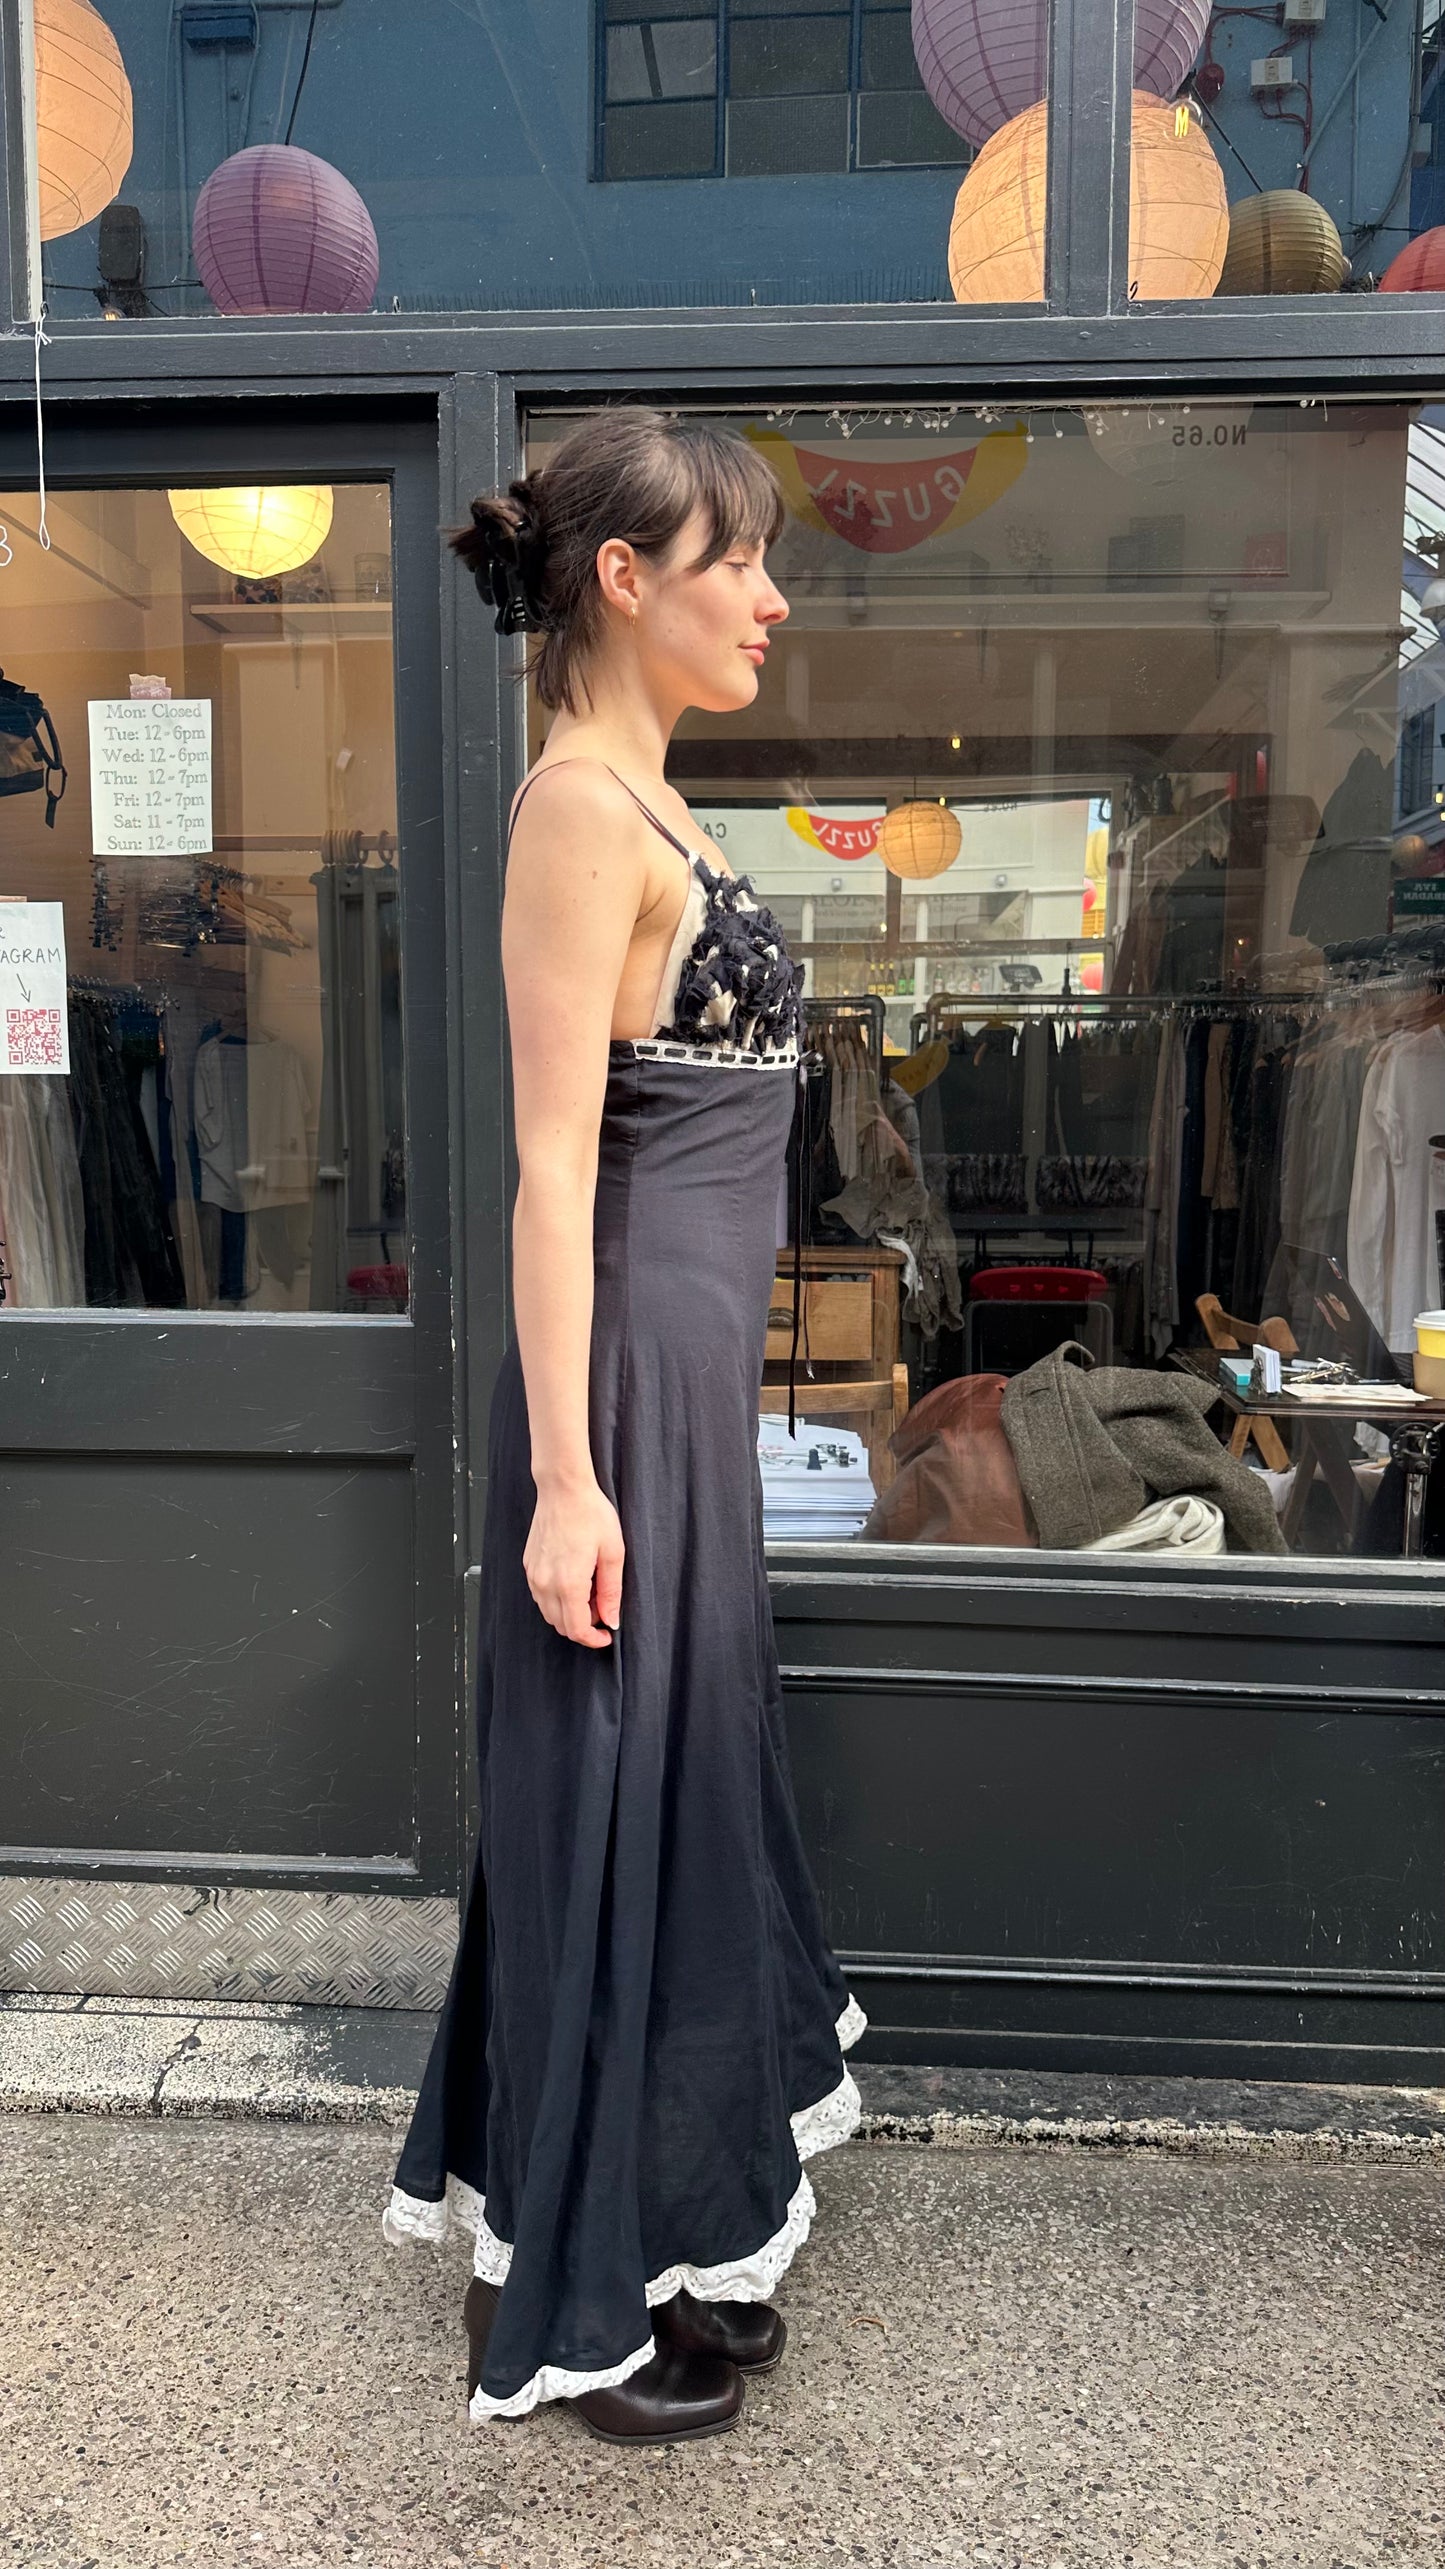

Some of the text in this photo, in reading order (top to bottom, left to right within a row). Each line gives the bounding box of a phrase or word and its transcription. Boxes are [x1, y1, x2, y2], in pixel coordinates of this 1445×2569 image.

[106, 703, 202, 719] Mon: Closed
[104, 726, 140, 741] Tue:
[102, 748, 144, 763] Wed:
[99, 770, 138, 785] Thu:
[113, 792, 140, 807] Fri:
[113, 814, 142, 829] Sat:
[107, 835, 142, 850] Sun:
